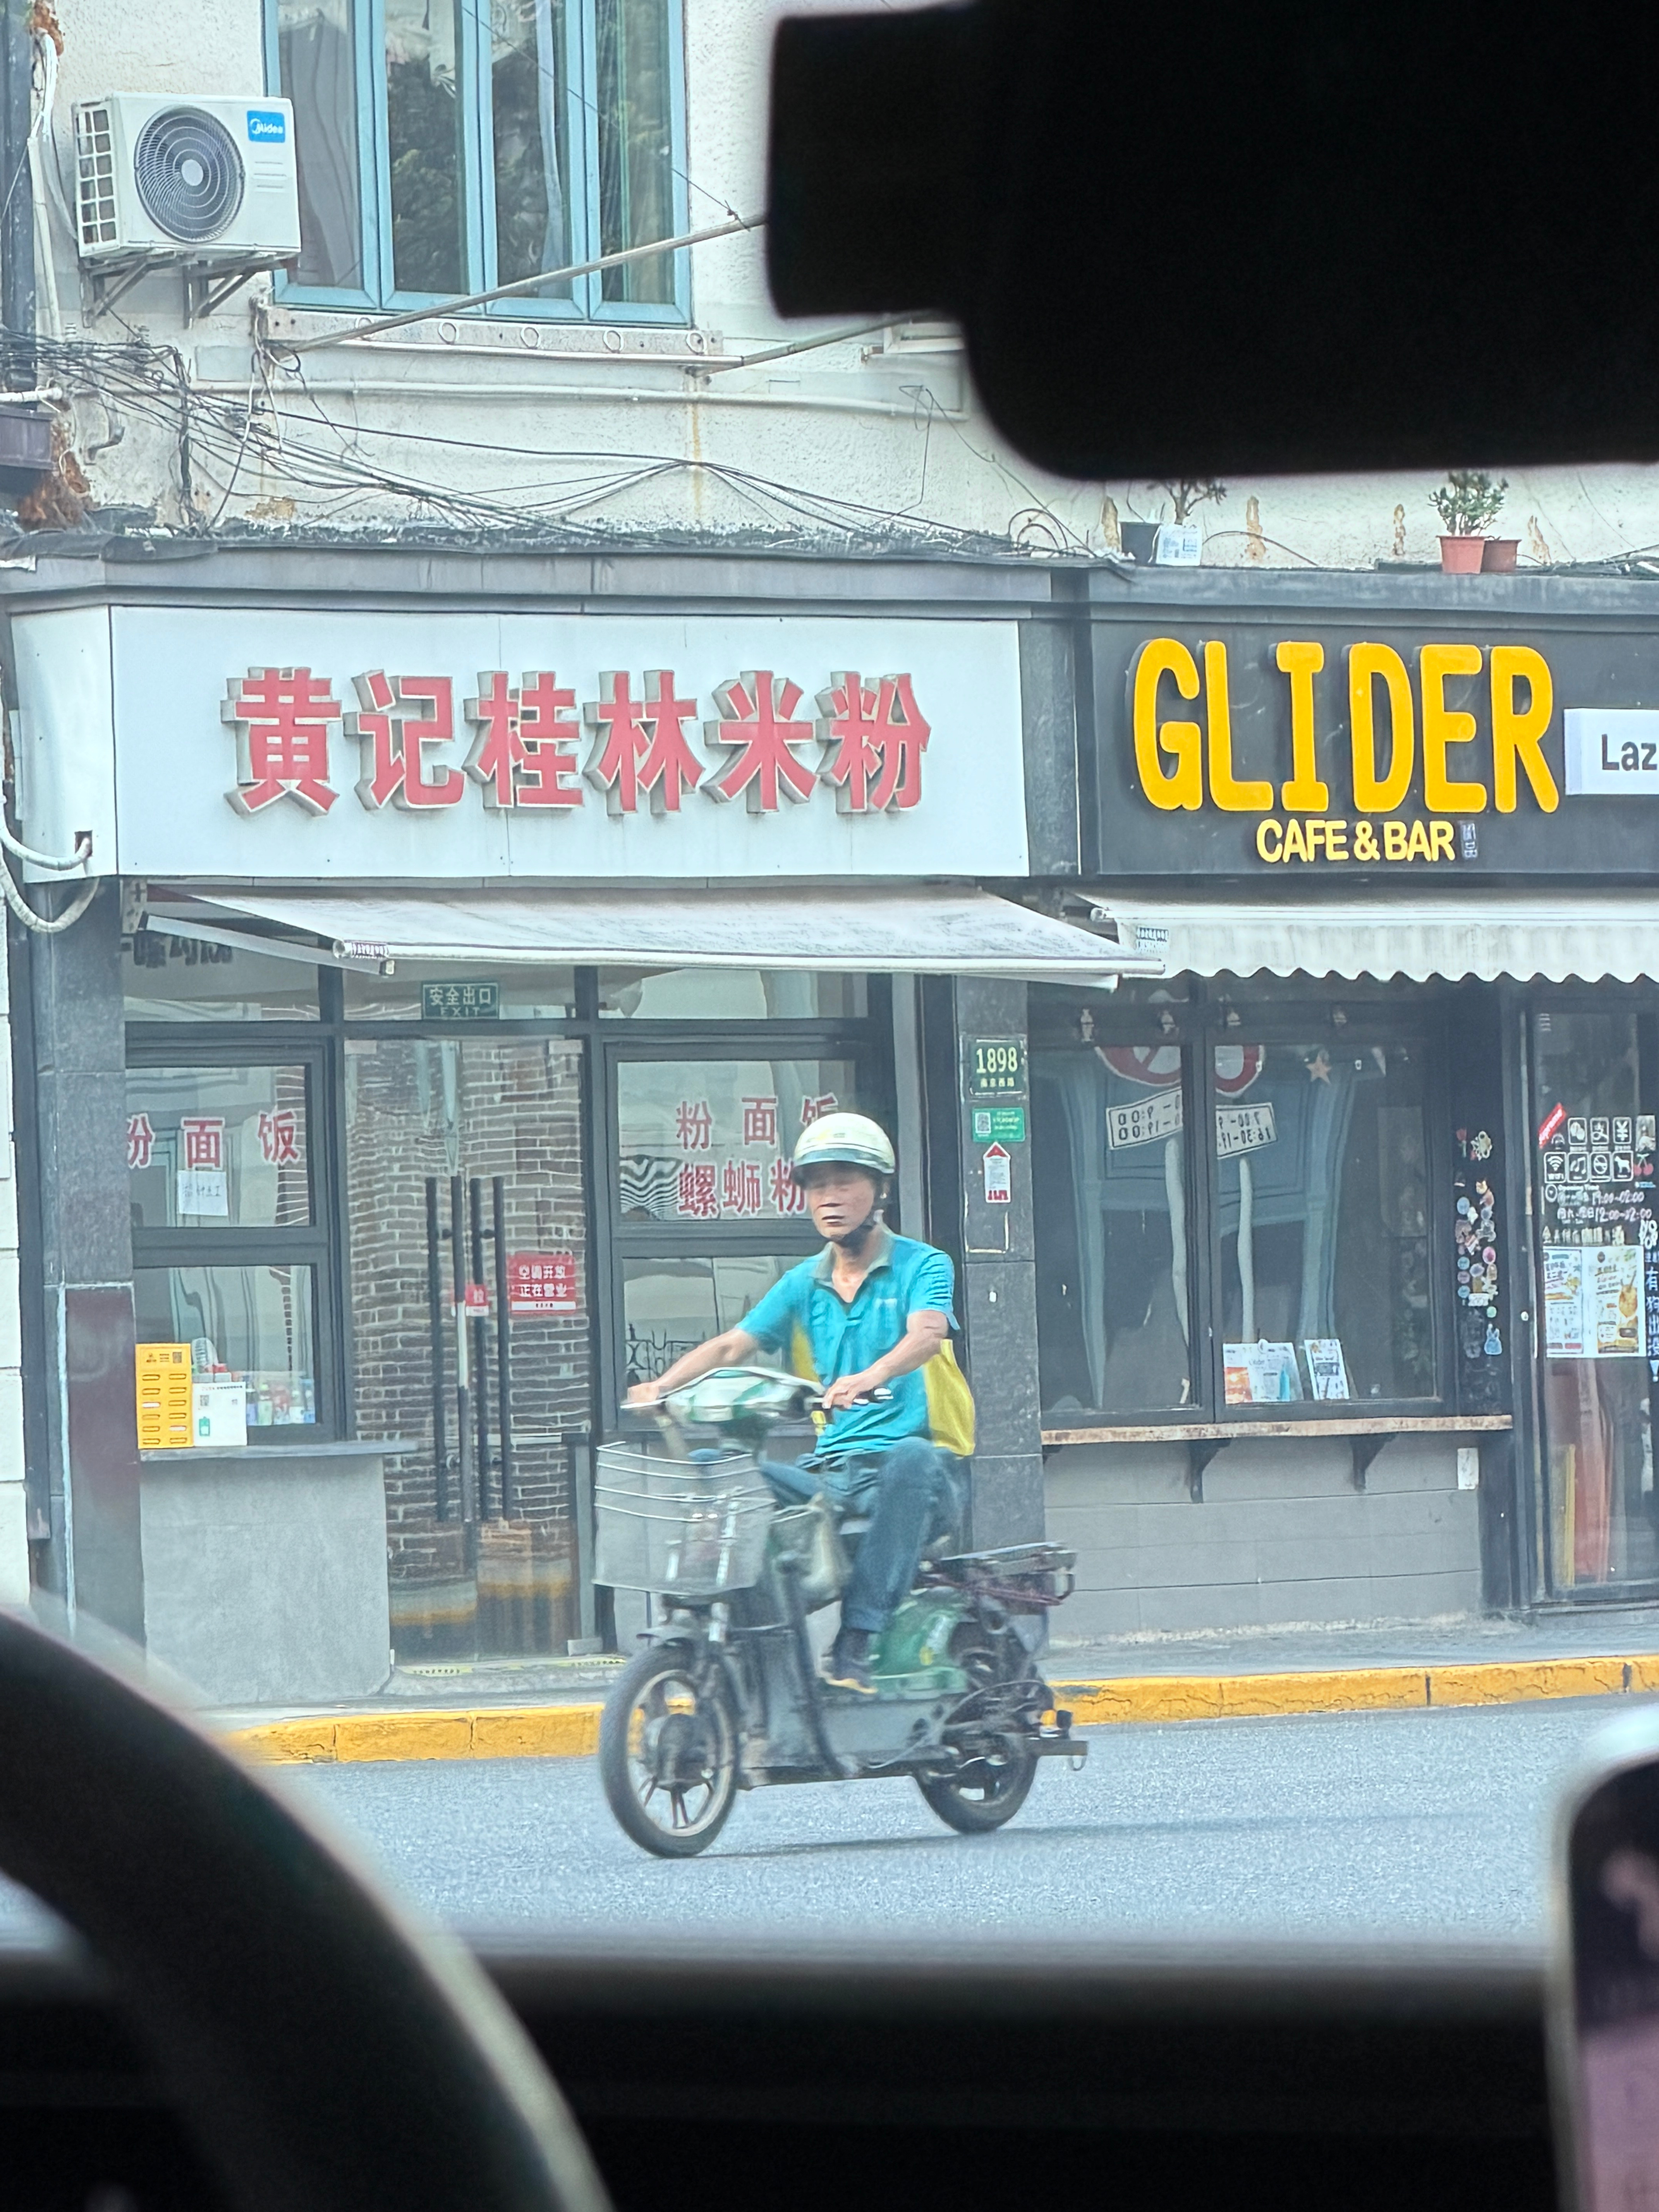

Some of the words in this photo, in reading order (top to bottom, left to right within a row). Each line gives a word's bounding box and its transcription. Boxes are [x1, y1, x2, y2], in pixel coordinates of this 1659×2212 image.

[249, 118, 283, 134] Midea
[1133, 638, 1559, 813] GLIDER
[222, 668, 931, 816] 黄记桂林米粉
[1601, 733, 1657, 771] Laz
[429, 986, 491, 1006] 安全出口
[441, 1007, 481, 1017] EXIT
[976, 1047, 1018, 1073] 1898
